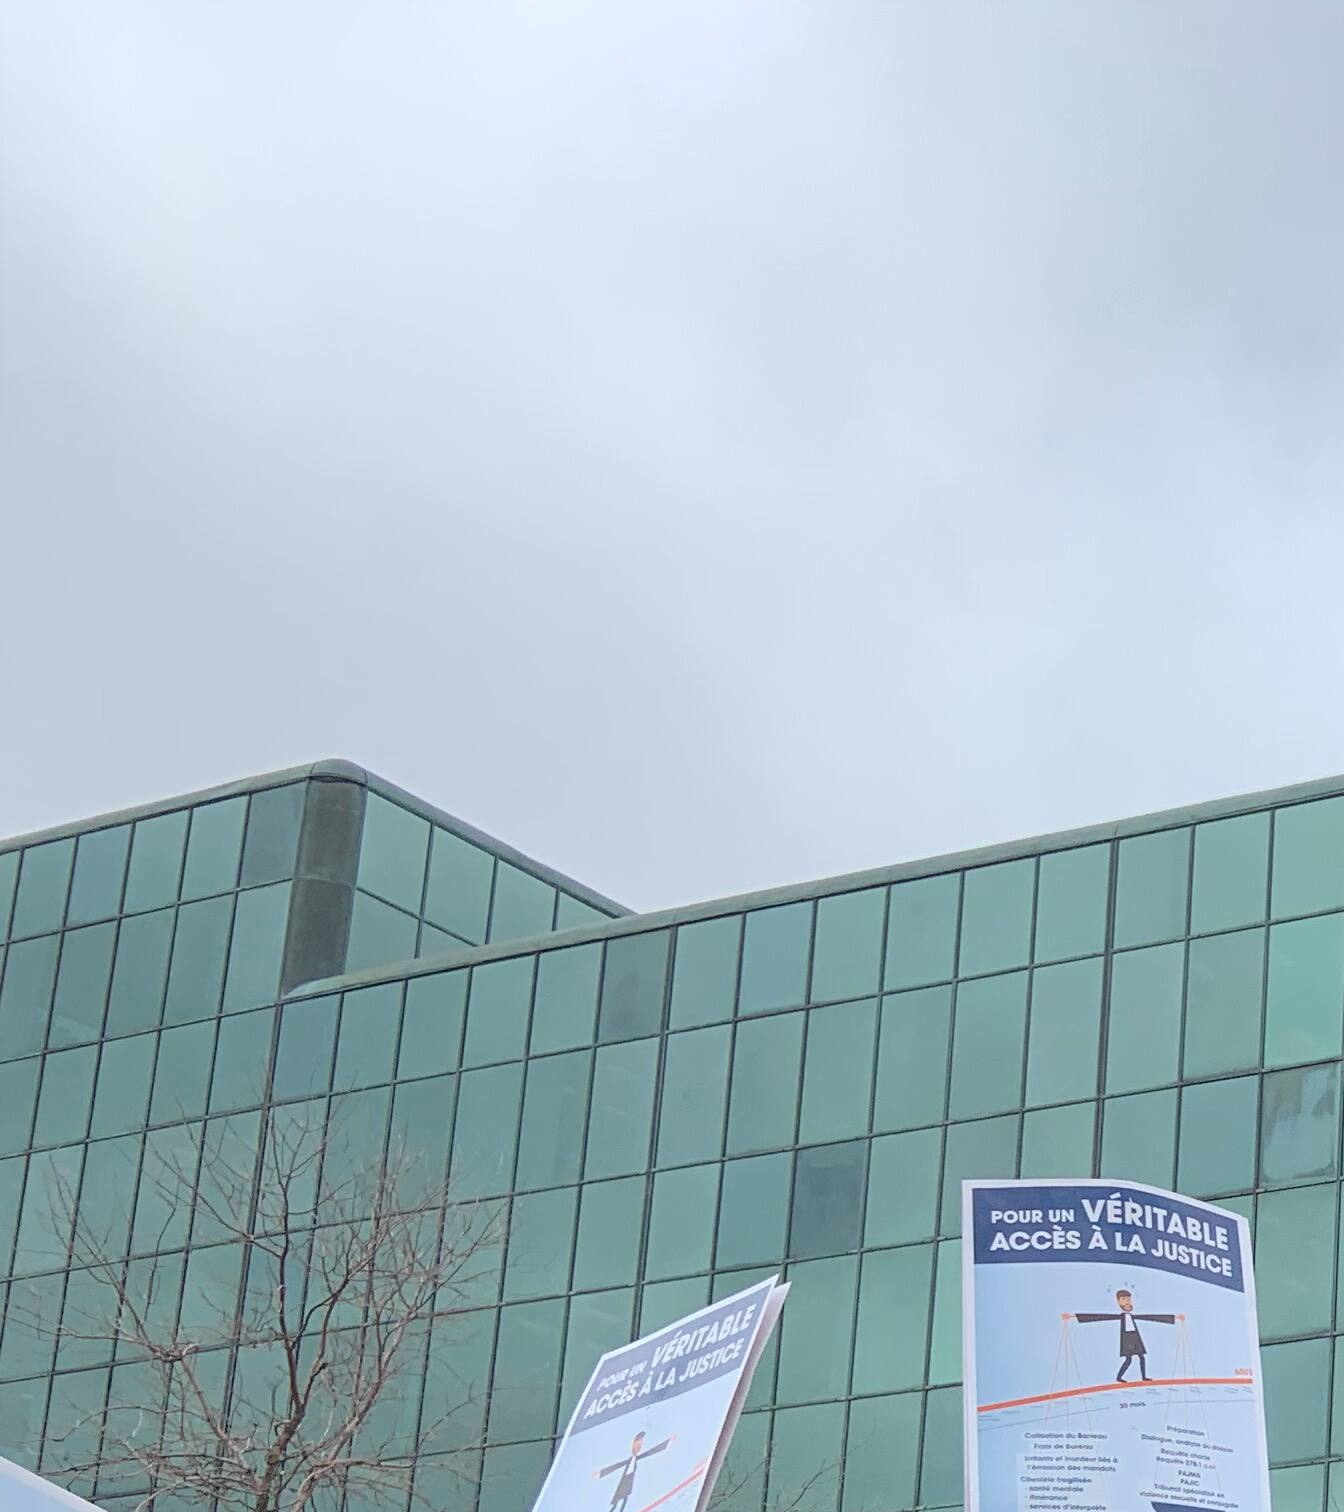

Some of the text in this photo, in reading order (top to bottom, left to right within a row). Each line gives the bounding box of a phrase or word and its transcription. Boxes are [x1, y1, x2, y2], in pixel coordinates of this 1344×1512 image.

[991, 1192, 1229, 1251] POUR UN VÉRITABLE
[990, 1225, 1233, 1278] ACCÈS À LA JUSTICE
[651, 1303, 757, 1368] VÉRITABLE
[654, 1367, 676, 1391] LA
[679, 1338, 745, 1382] JUSTICE
